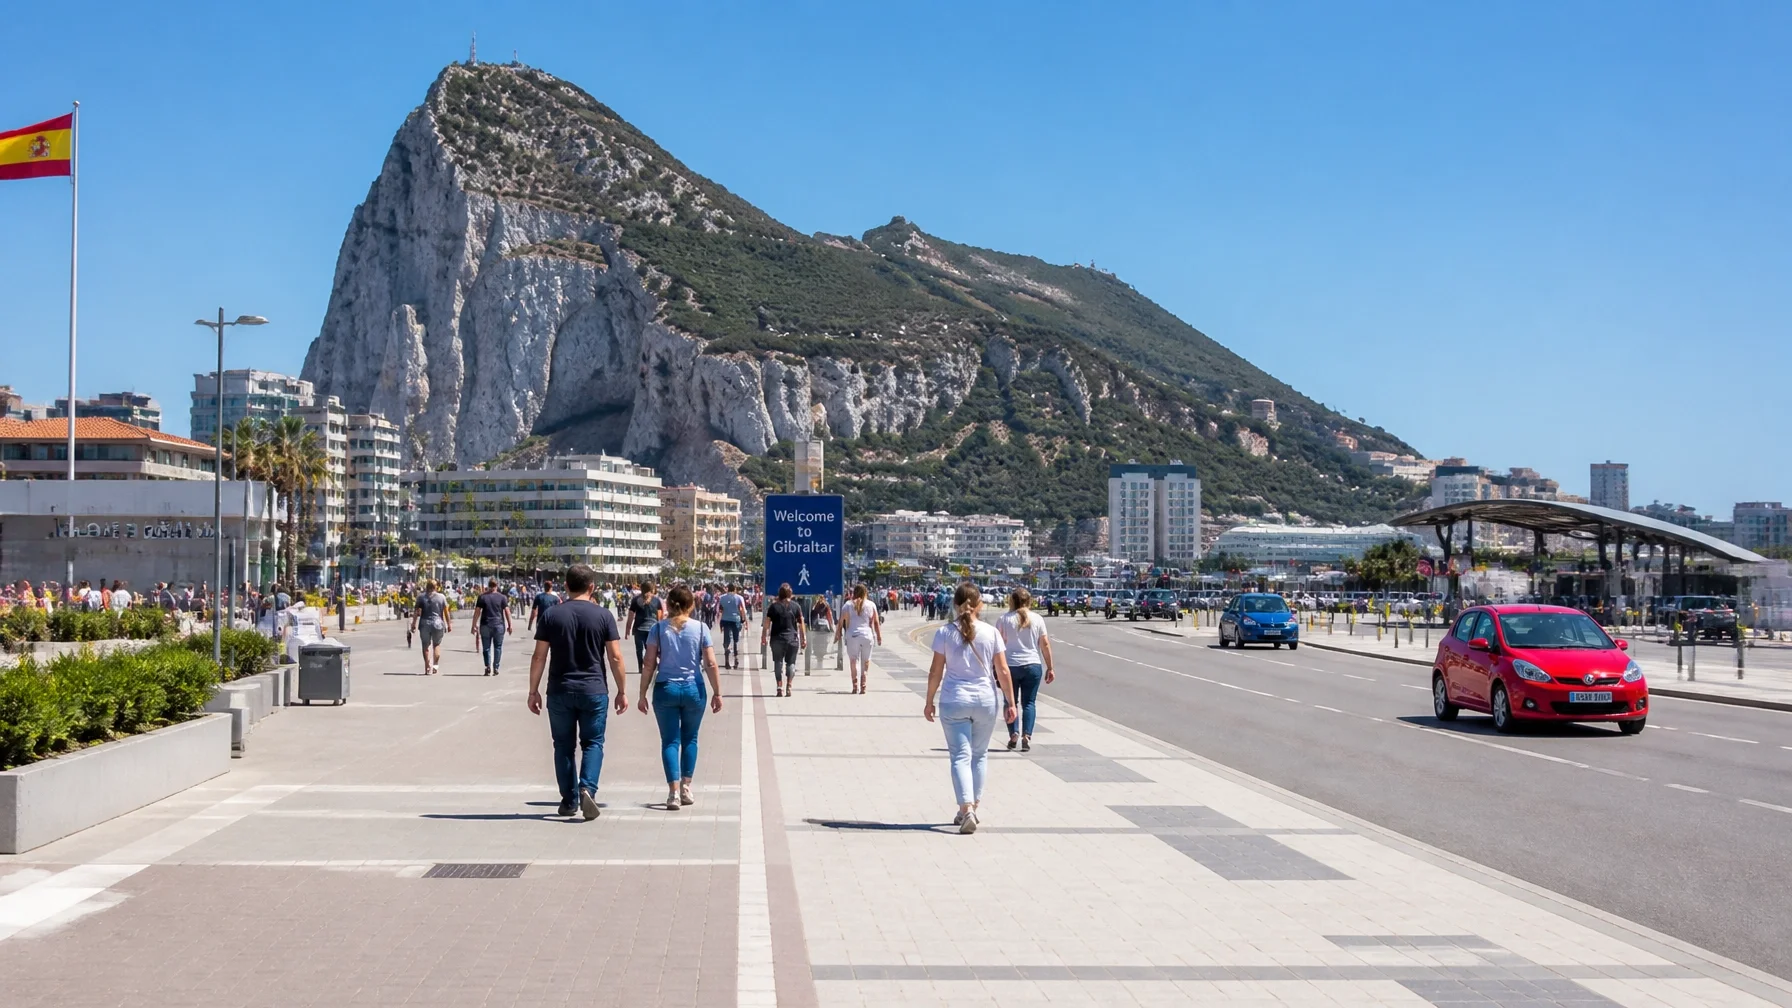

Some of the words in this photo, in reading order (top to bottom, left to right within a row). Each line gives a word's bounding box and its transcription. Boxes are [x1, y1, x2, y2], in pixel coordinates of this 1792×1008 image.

[773, 509, 835, 522] Welcome
[797, 526, 812, 537] to
[773, 540, 835, 553] Gibraltar
